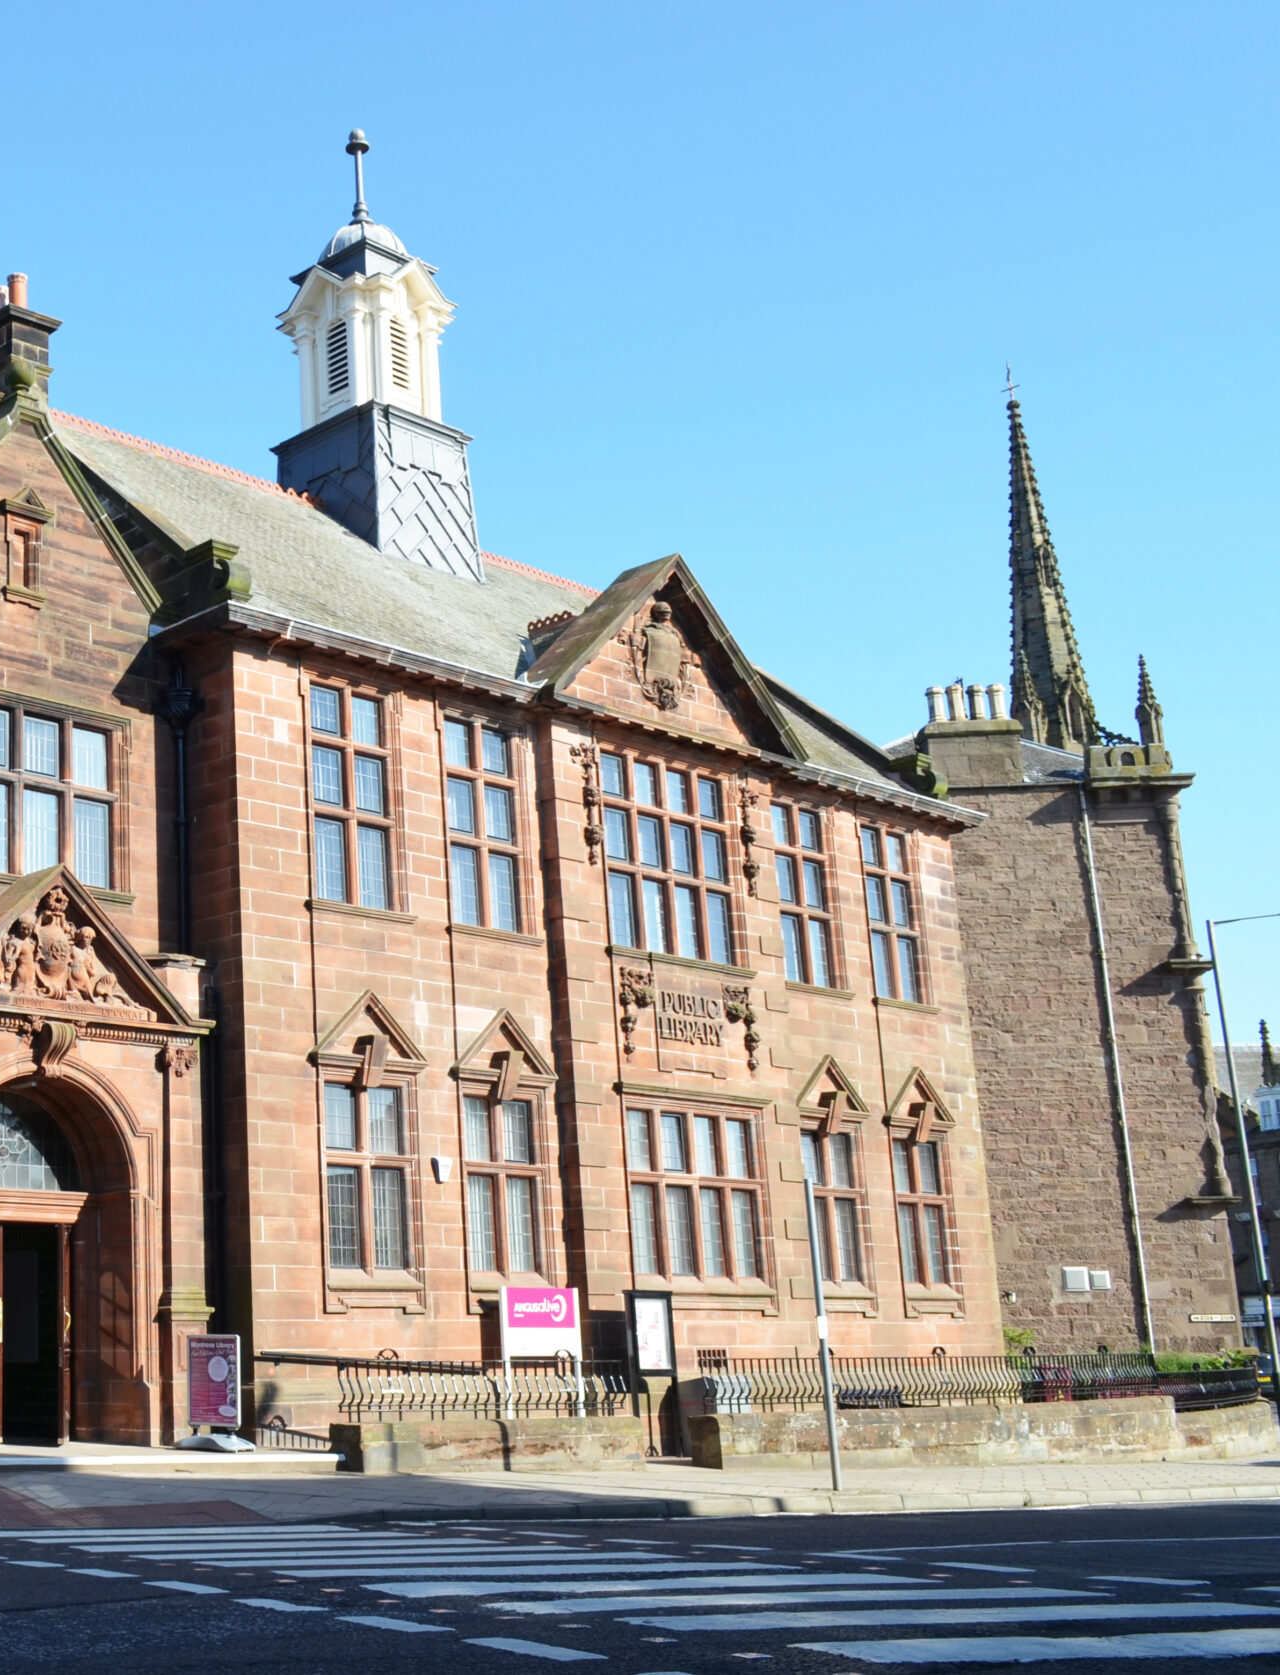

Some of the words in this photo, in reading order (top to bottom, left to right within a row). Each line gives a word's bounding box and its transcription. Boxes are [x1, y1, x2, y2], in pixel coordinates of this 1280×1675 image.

[100, 1007, 144, 1021] DECORAT
[661, 991, 720, 1019] PUBLIC
[659, 1016, 723, 1047] LIBRARY
[216, 1341, 235, 1349] Library
